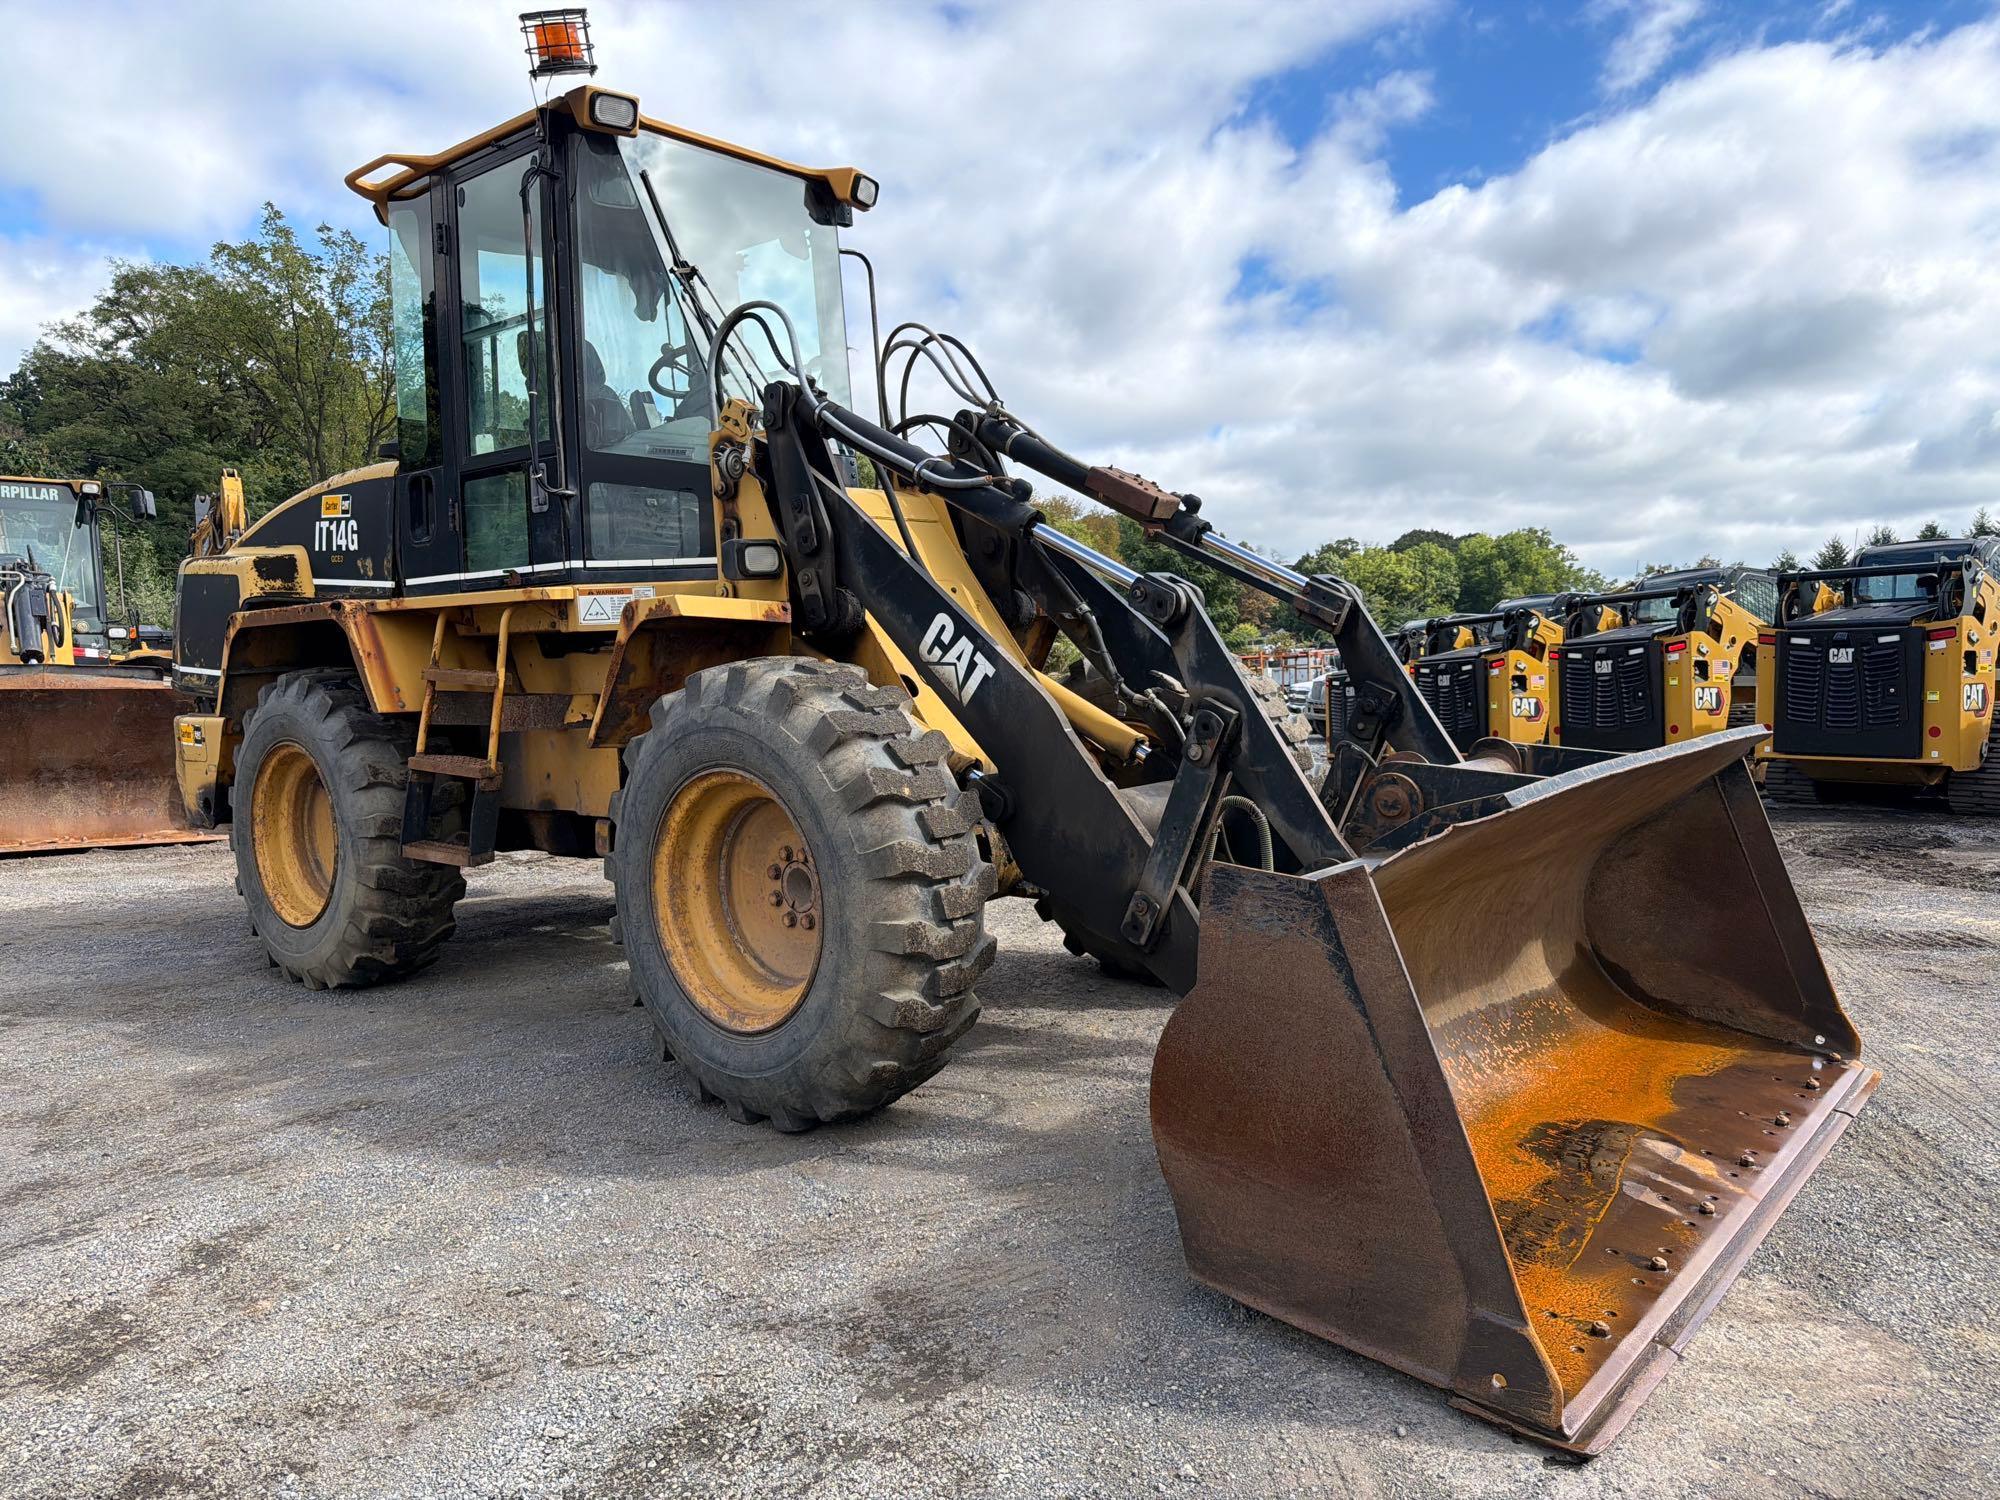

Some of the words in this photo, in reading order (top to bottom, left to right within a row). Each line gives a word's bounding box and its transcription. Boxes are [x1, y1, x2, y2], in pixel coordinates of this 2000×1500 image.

[314, 519, 359, 552] IT14G
[595, 588, 625, 596] WARNING
[918, 612, 997, 708] CAT
[1828, 647, 1855, 664] CAT
[1594, 659, 1614, 674] CAT
[1437, 674, 1451, 687] CAT
[1512, 697, 1537, 717] CAT
[1694, 687, 1719, 711] CAT
[1963, 683, 1984, 711] CAT
